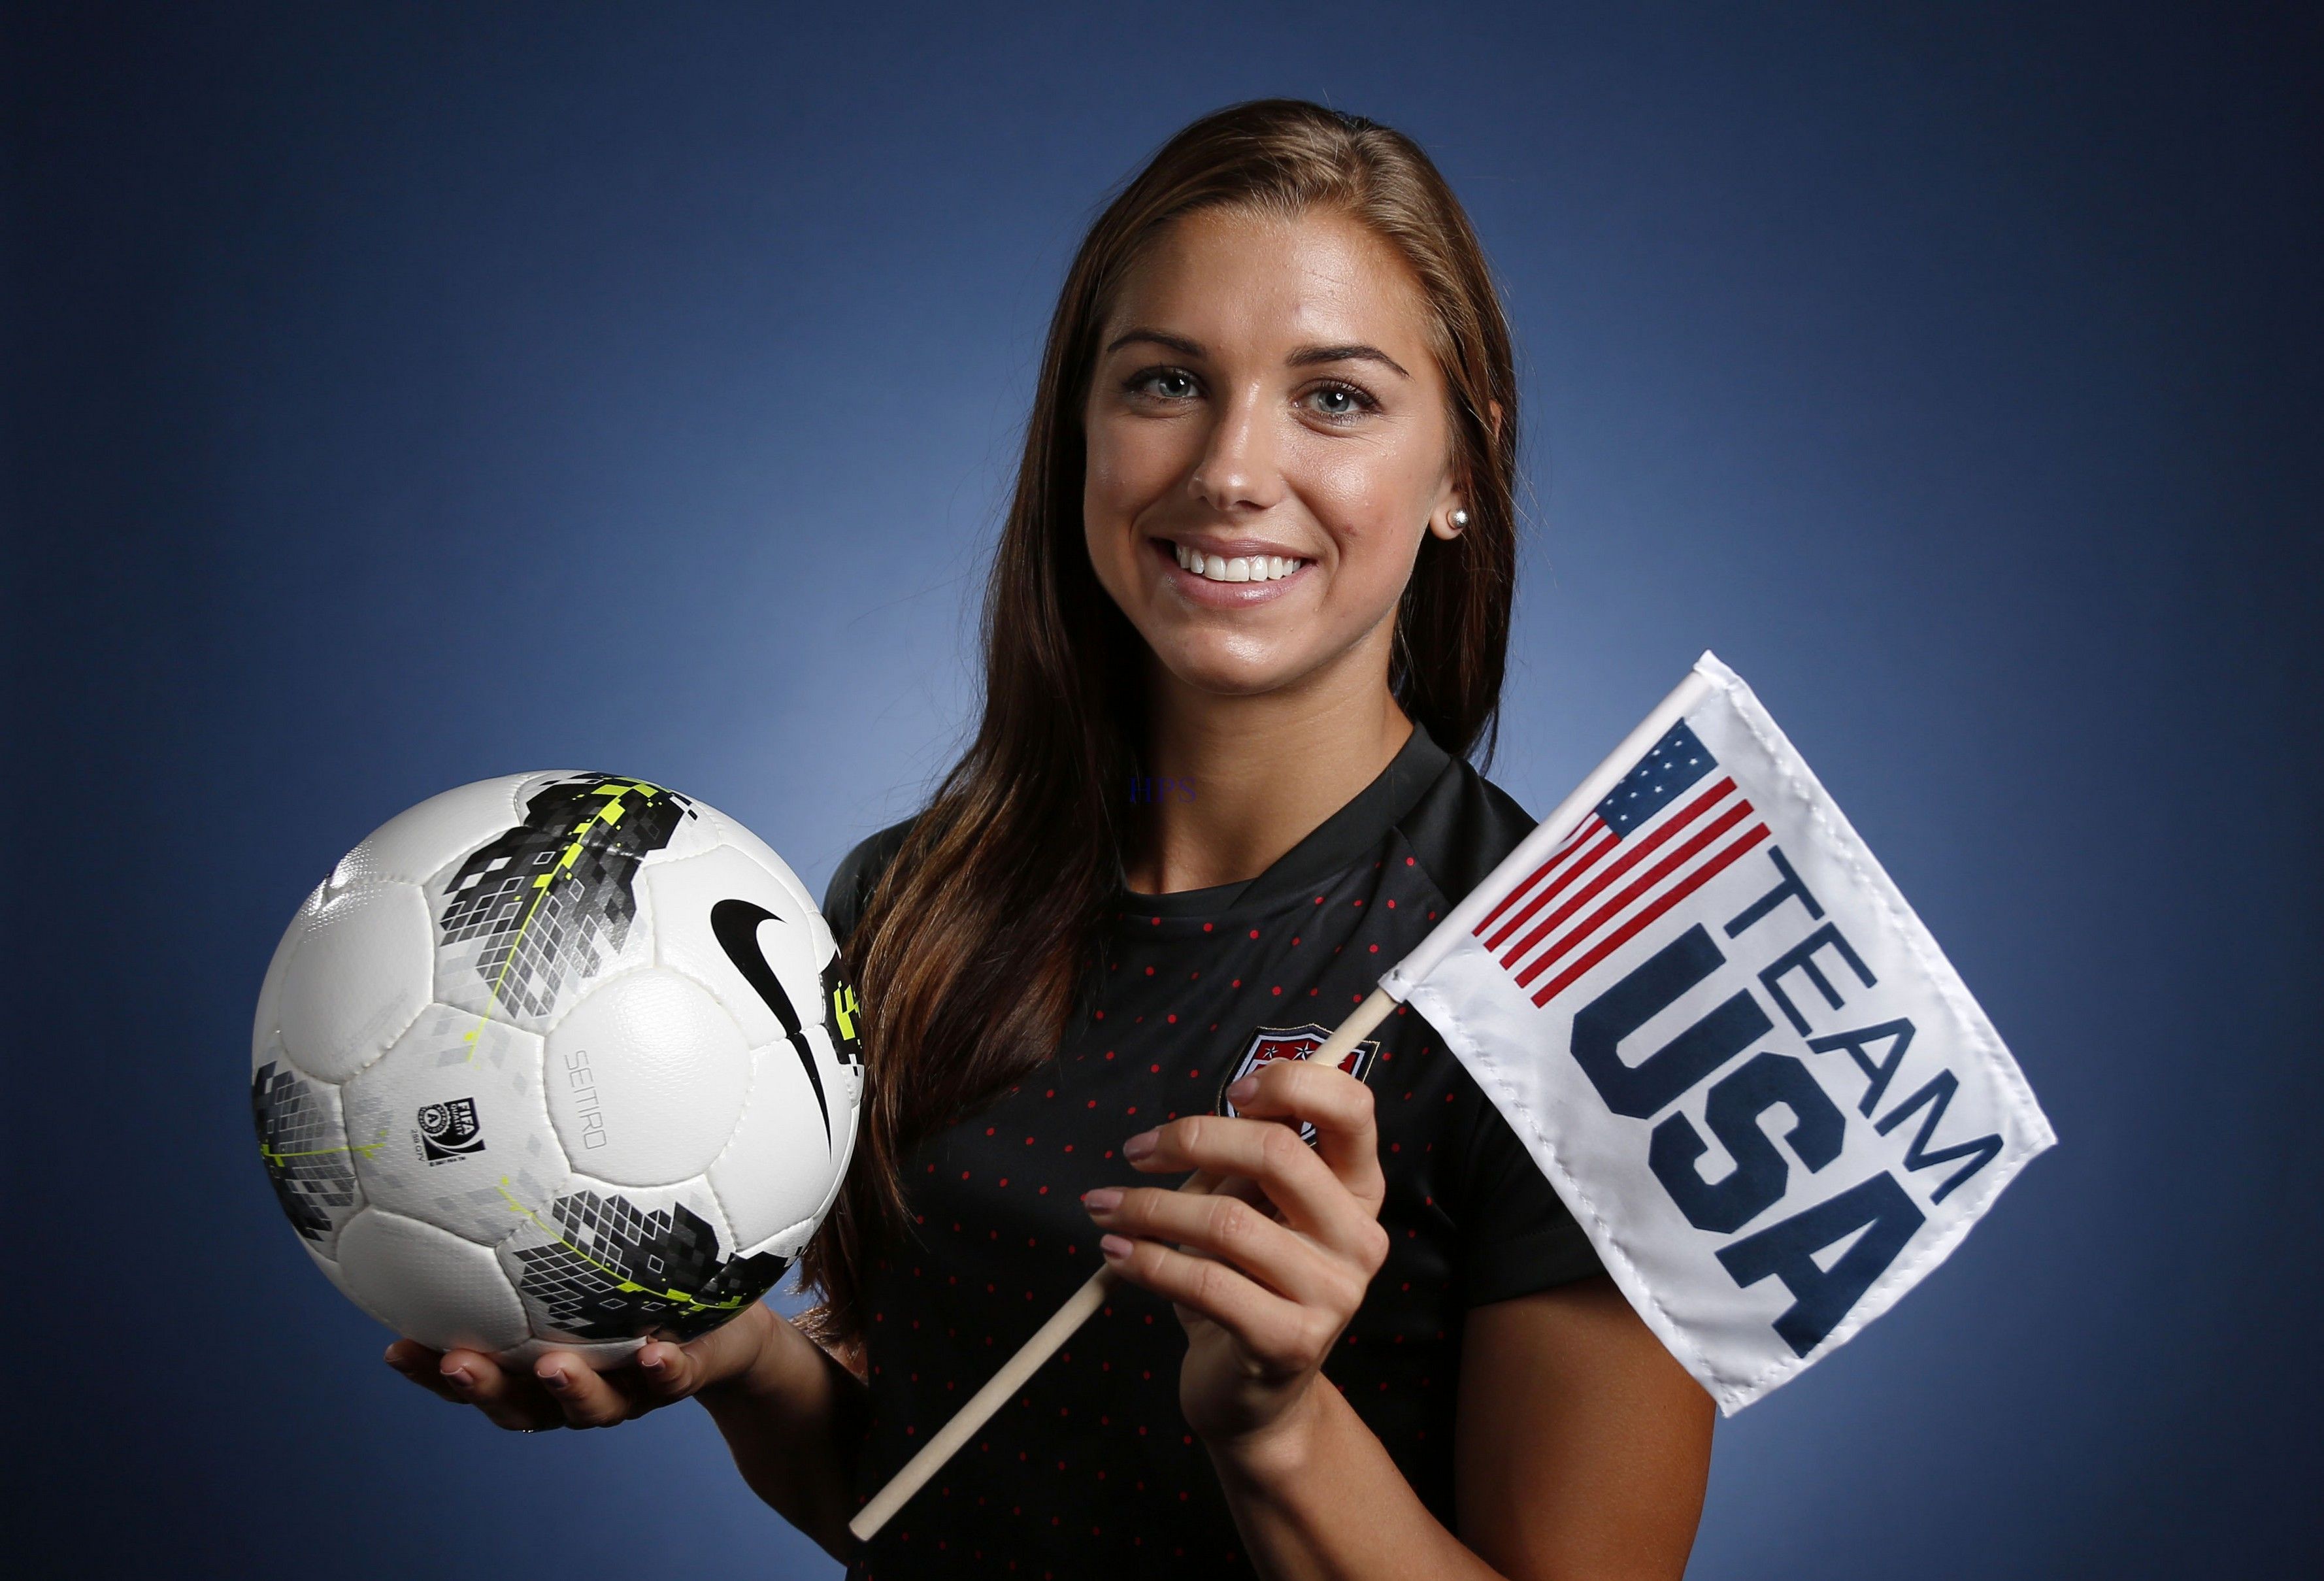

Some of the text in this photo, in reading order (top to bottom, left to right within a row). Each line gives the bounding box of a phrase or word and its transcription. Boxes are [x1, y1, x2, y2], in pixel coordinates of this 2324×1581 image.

[1723, 845, 2004, 1206] TEAM
[450, 1103, 465, 1135] QUALITY
[457, 1101, 475, 1135] FIFA
[564, 1050, 607, 1150] SEITIRO
[1569, 922, 1927, 1359] USA
